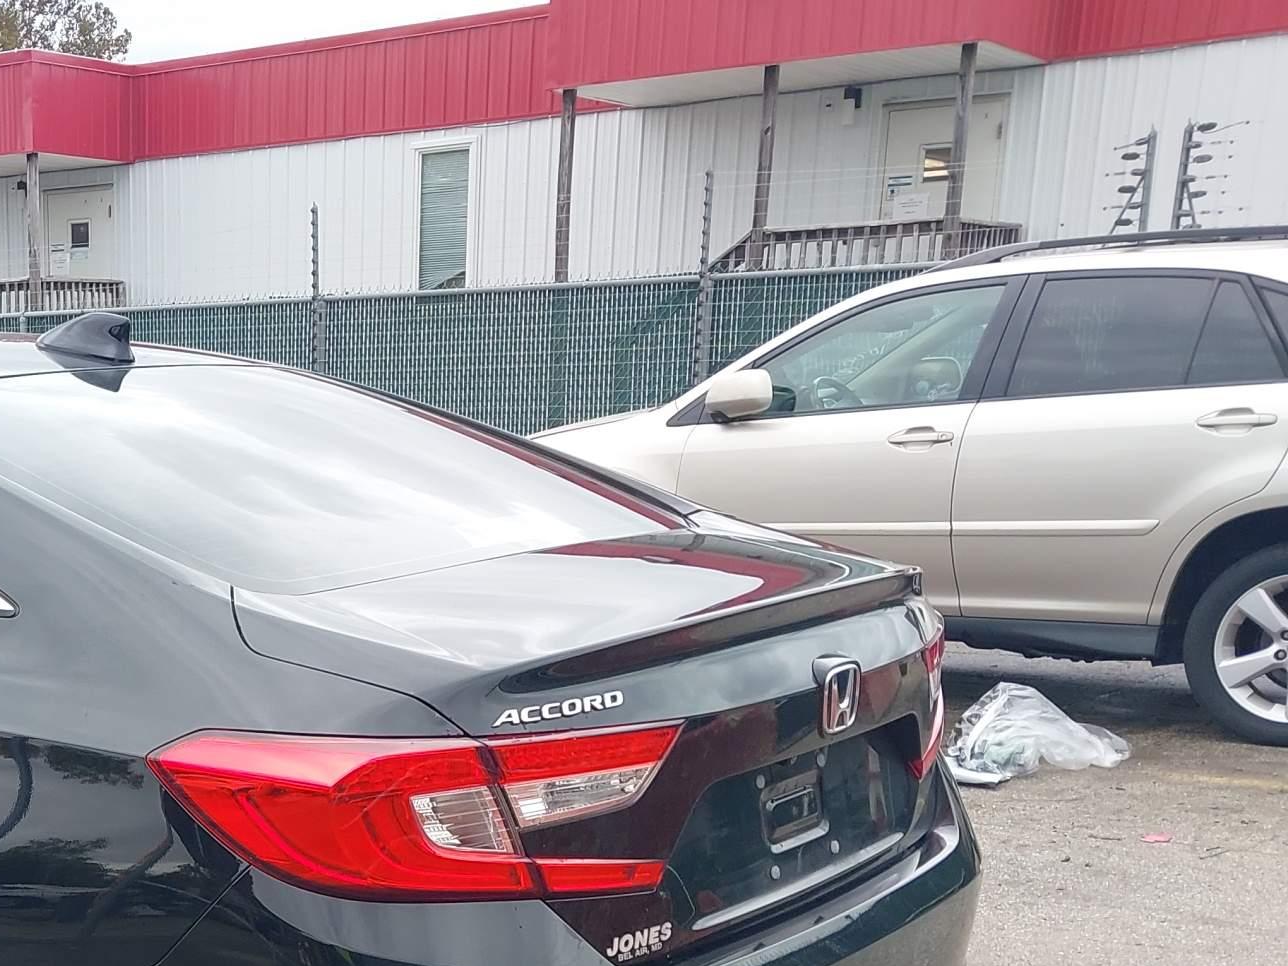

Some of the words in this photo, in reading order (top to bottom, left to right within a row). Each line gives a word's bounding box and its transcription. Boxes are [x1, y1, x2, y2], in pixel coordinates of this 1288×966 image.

[492, 690, 624, 727] ACCORD
[606, 921, 672, 957] JONES
[618, 951, 633, 962] BEL
[651, 942, 663, 951] MD
